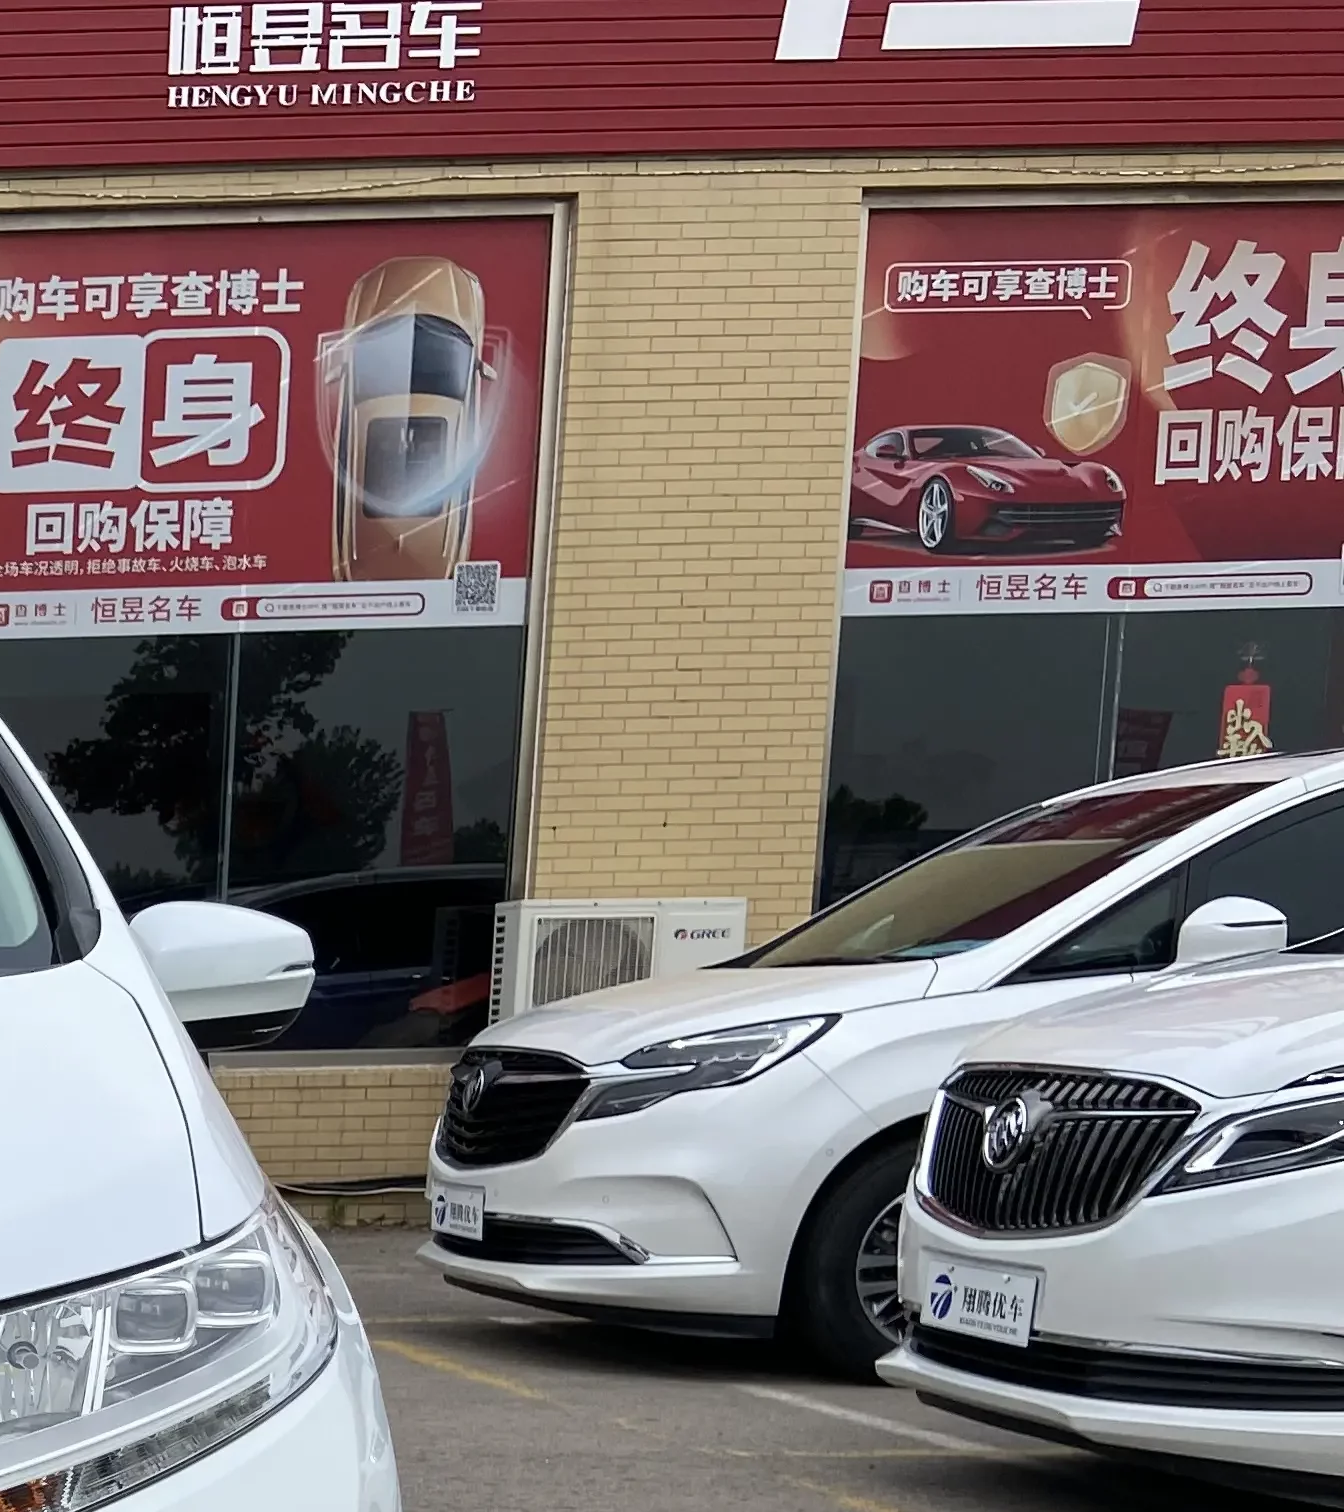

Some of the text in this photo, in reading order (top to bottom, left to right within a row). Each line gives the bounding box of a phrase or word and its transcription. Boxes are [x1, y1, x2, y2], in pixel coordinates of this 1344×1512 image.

[167, 1, 483, 76] 恒昱名车
[167, 79, 476, 108] HENGYU MINGCHE
[897, 267, 1119, 302] 购车可享查博士
[10, 353, 266, 470] 终身
[1154, 404, 1344, 486] 回购保
[25, 497, 234, 556] 回购保障
[90, 595, 202, 625] 恒昱名车
[975, 572, 1089, 602] 恒昱名车
